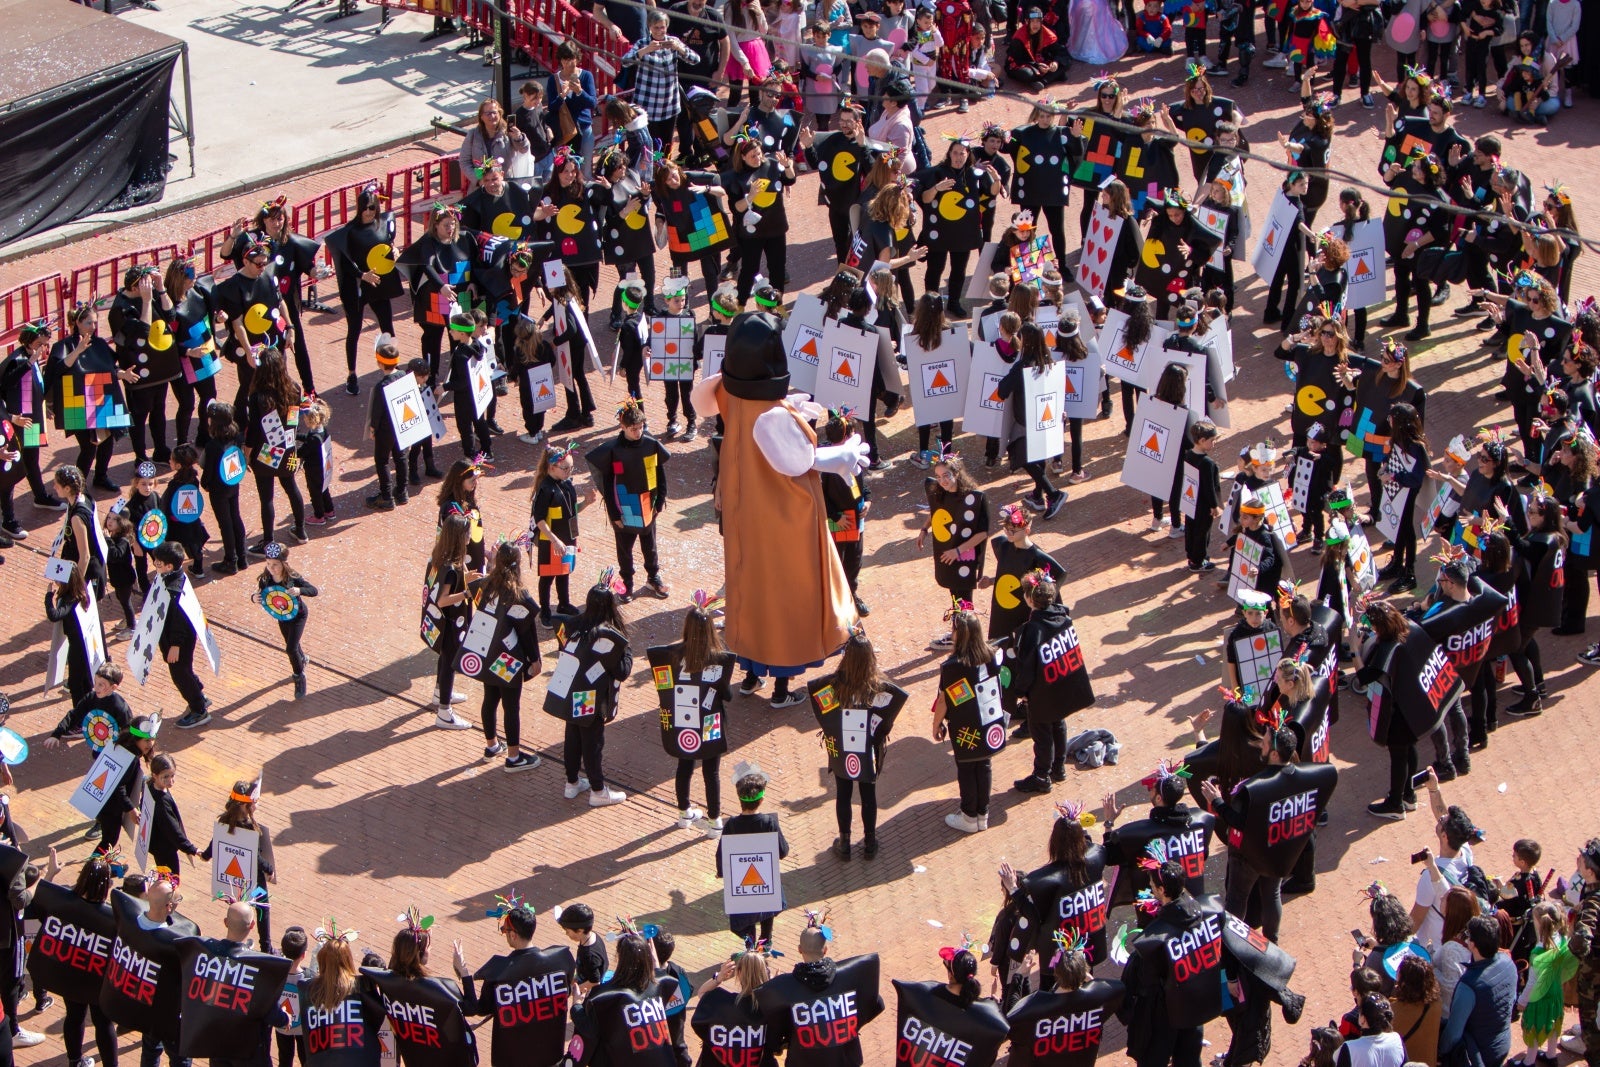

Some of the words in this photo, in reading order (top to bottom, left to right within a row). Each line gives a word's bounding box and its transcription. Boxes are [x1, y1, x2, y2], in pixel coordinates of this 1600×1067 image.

[483, 235, 509, 264] AME
[1361, 272, 1373, 281] CIM
[1041, 322, 1058, 330] scola
[793, 350, 803, 360] EL
[805, 354, 820, 365] CIM
[837, 350, 855, 360] escola
[928, 362, 948, 371] escola
[1110, 354, 1119, 363] EL
[1122, 359, 1137, 370] CIM
[832, 372, 842, 381] EL
[843, 375, 856, 385] CIM
[927, 388, 937, 396] EL
[940, 384, 955, 394] CIM
[396, 394, 411, 405] escola
[984, 400, 994, 408] EL
[400, 422, 408, 432] EL
[409, 416, 421, 427] CIM
[1148, 423, 1164, 435] escola
[1140, 445, 1149, 455] EL
[1150, 450, 1162, 461] CIM
[1039, 625, 1080, 665] GAME
[1446, 615, 1497, 651] GAME
[1318, 643, 1337, 679] AME
[1418, 643, 1449, 695] GAME
[1427, 660, 1460, 713] OVER
[104, 760, 117, 773] escola
[85, 782, 93, 791] EL
[93, 787, 104, 798] CIM
[1268, 789, 1319, 824] GAME
[1266, 810, 1316, 845] OVER
[224, 846, 244, 857] escola
[738, 854, 764, 863] escola
[1166, 828, 1204, 859] AME
[219, 872, 229, 883] EL
[735, 885, 747, 894] EL
[751, 884, 770, 894] CIM
[1059, 881, 1105, 919] GAME
[44, 915, 112, 958] GAME
[1167, 914, 1221, 962] GAME
[39, 934, 107, 976] OVER
[112, 935, 162, 985] GAME
[106, 958, 157, 1006] OVER
[194, 952, 260, 990] GAME
[187, 976, 252, 1014] OVER
[495, 971, 568, 1006] GAME
[307, 999, 364, 1030] GAME
[383, 992, 437, 1028] GAME
[499, 992, 569, 1028] OVER
[622, 996, 668, 1028] GAM
[790, 990, 857, 1026] GAME
[1034, 1007, 1103, 1039] GAME
[308, 1023, 365, 1054] OVER
[390, 1014, 442, 1048] VER
[628, 1019, 673, 1051] OV
[710, 1024, 767, 1048] GAM
[795, 1016, 858, 1048] OVER
[901, 1016, 972, 1066] GAME
[1032, 1027, 1100, 1057] OVER
[711, 1046, 763, 1067] OVE
[896, 1038, 963, 1067] OV
